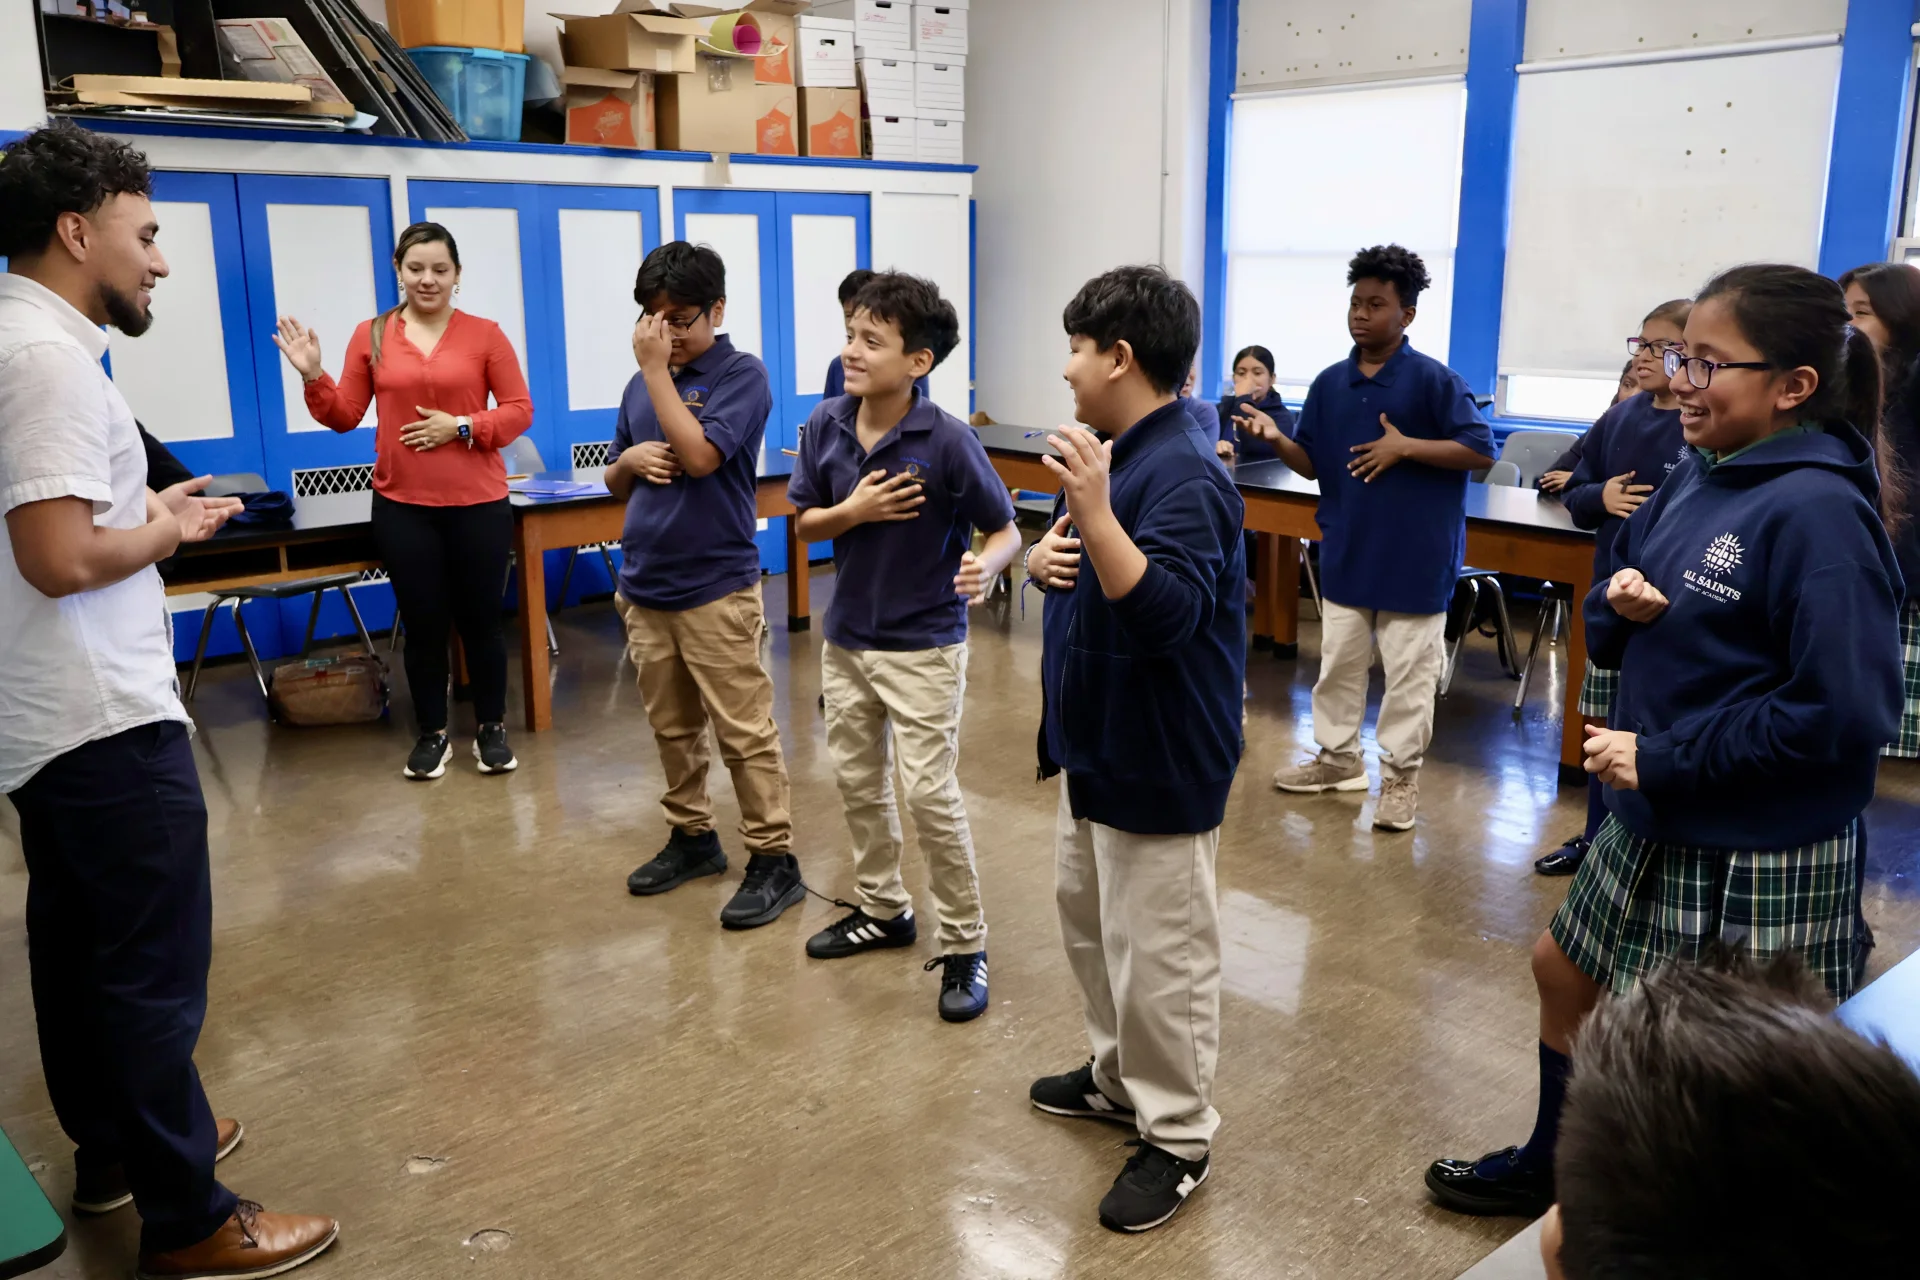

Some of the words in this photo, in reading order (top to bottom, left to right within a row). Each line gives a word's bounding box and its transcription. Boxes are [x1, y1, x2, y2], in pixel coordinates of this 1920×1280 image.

[1683, 570, 1697, 582] ALL
[1696, 575, 1741, 601] SAINTS
[1701, 591, 1727, 603] ACADEMY
